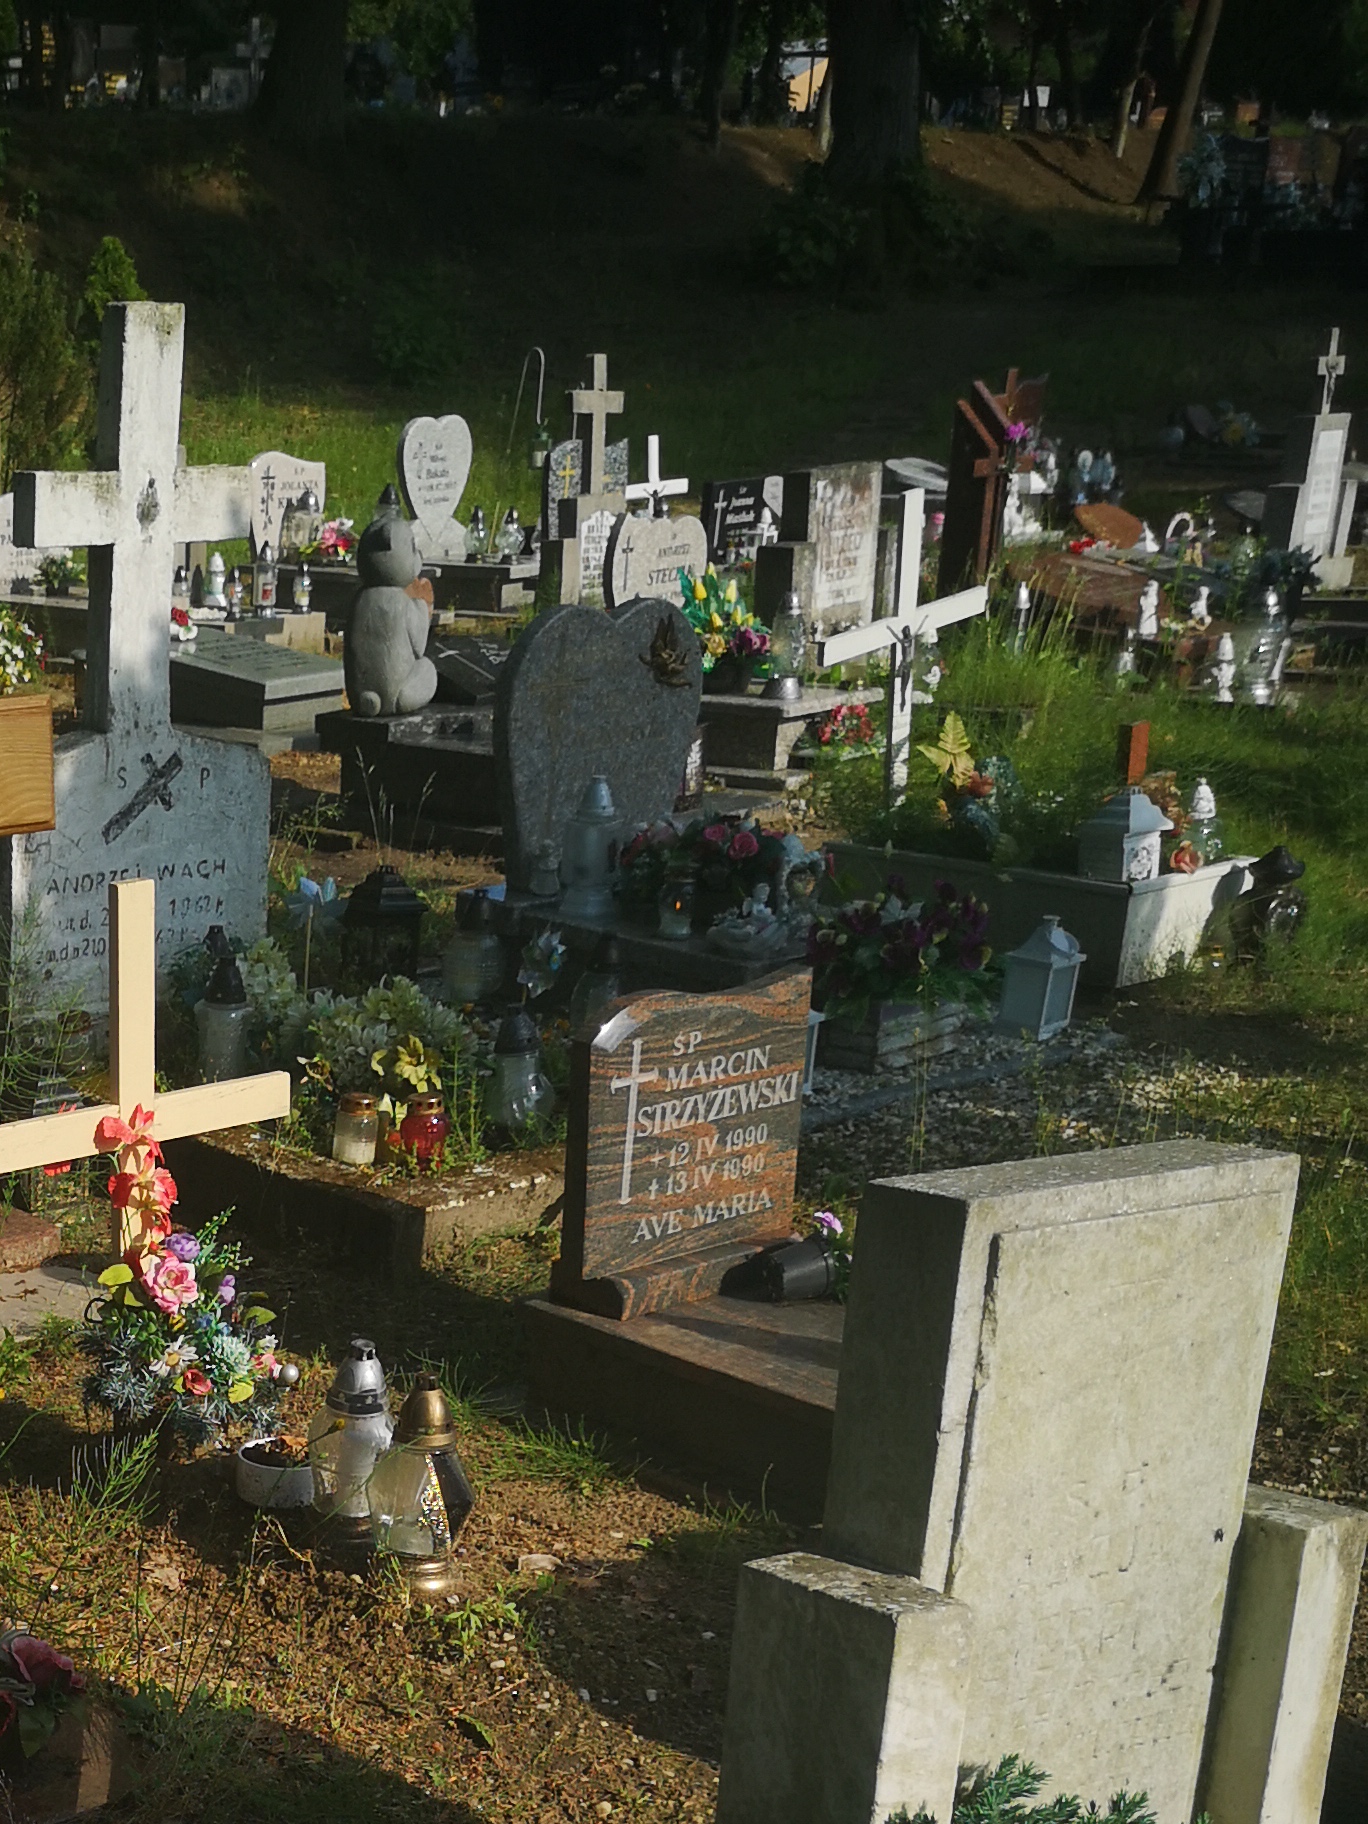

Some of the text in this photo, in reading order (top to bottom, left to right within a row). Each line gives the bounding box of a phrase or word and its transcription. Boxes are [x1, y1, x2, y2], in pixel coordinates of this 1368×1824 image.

[200, 767, 211, 789] P
[157, 858, 226, 881] WACH
[664, 1045, 772, 1093] MARCIN
[636, 1070, 801, 1139] STRZYŻEWSKI
[694, 1134, 722, 1160] IV
[725, 1122, 768, 1153] 1990
[692, 1164, 718, 1190] IV
[721, 1153, 766, 1182] 1990
[631, 1187, 774, 1245] AVE MARIA
